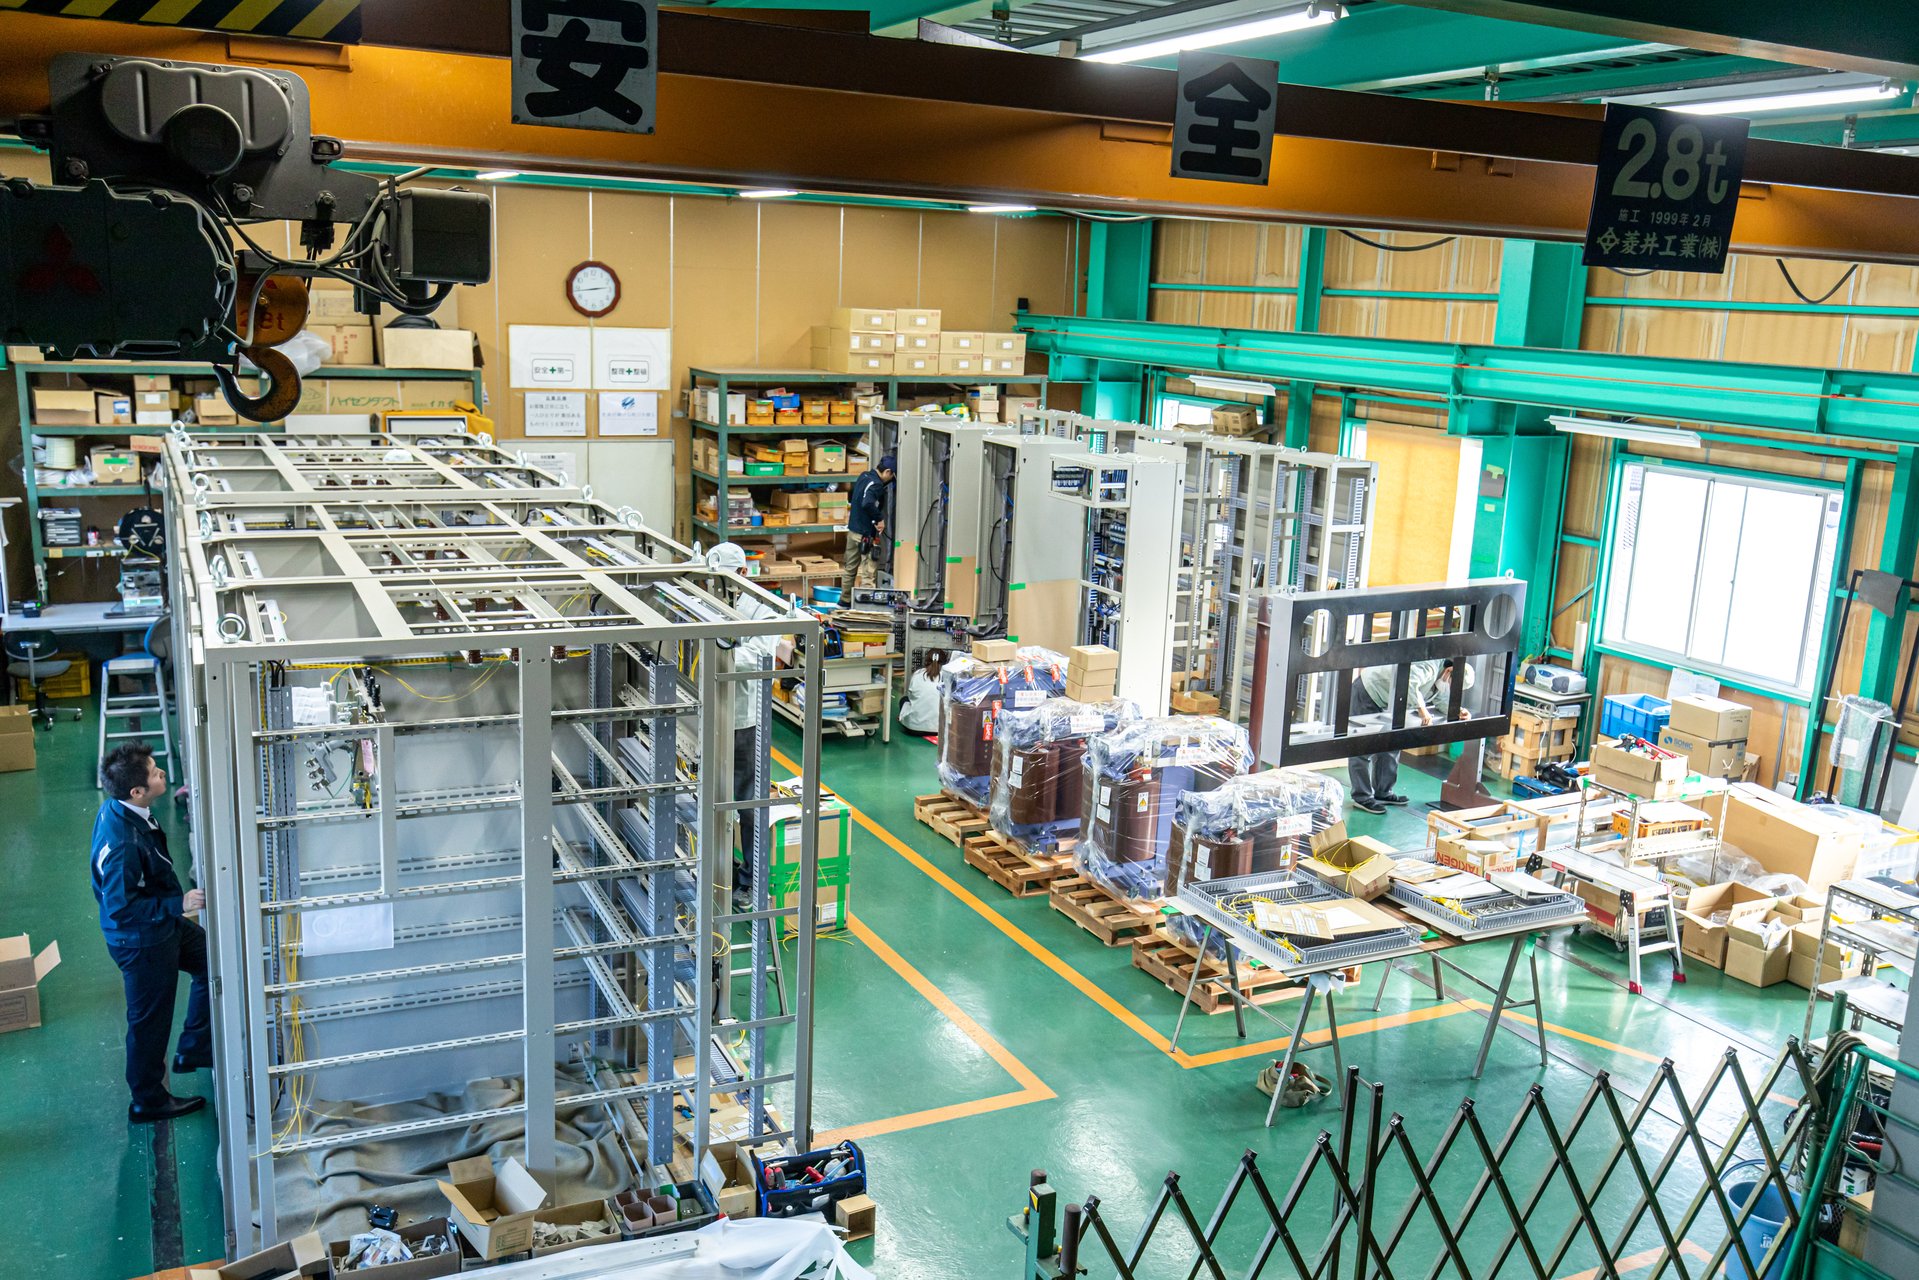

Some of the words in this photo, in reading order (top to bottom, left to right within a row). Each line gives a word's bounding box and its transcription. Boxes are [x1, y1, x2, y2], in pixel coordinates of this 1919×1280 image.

[521, 0, 648, 125] 安
[1180, 62, 1271, 177] 全
[1612, 118, 1729, 204] 2.8t
[1618, 208, 1641, 223] 施工
[1436, 851, 1479, 875] TAKIGEN
